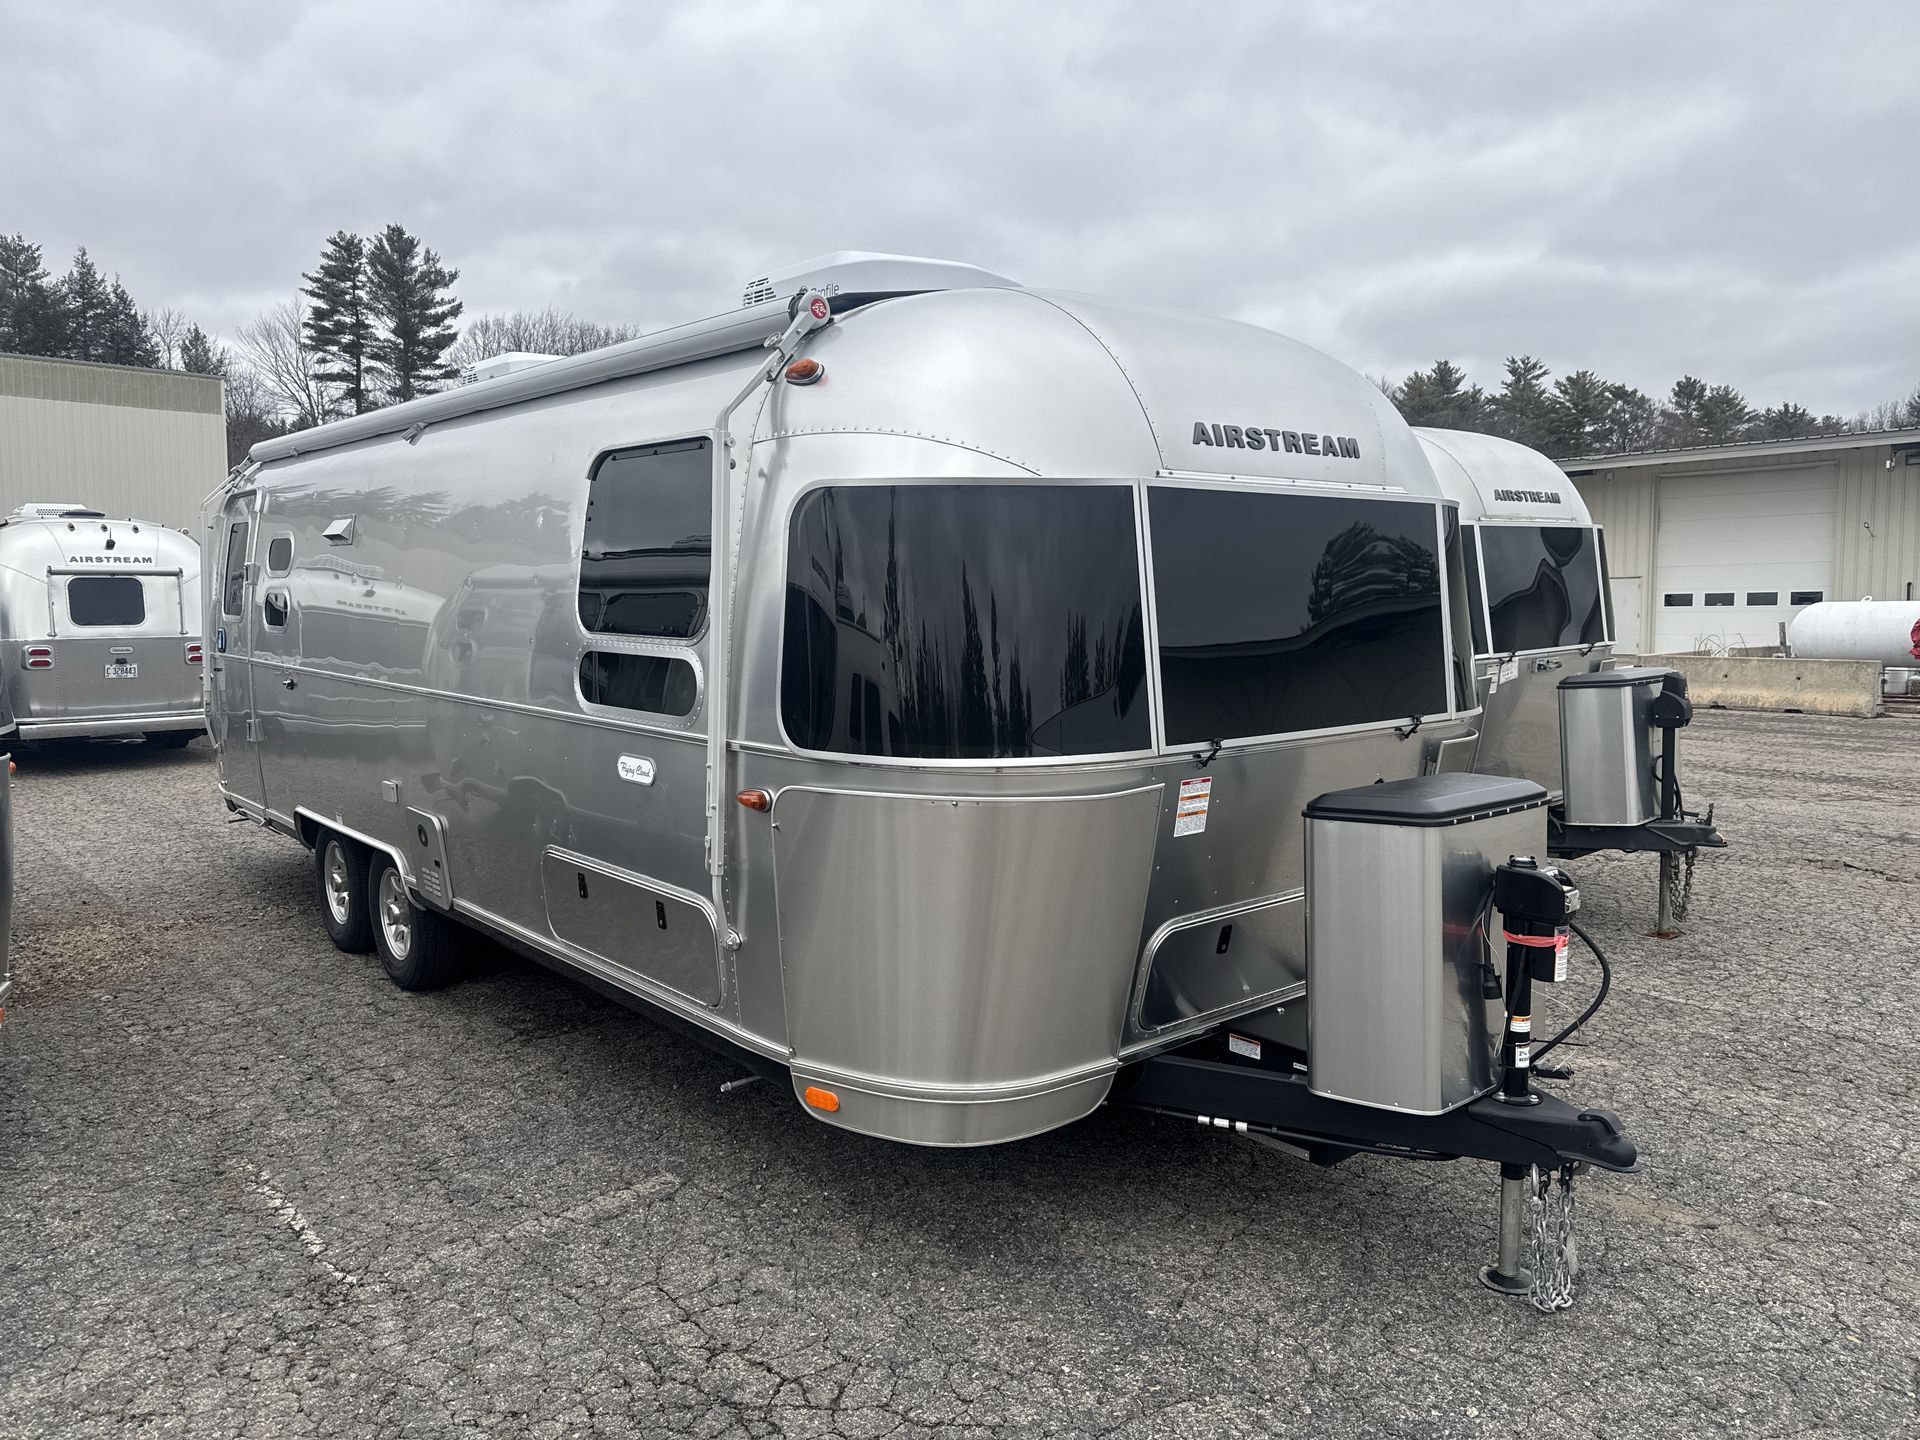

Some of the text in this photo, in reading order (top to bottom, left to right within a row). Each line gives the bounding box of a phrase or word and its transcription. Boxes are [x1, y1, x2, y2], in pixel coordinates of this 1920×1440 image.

[1192, 422, 1360, 459] AIRSTREAM
[1494, 489, 1561, 504] AIRSTREAM
[620, 761, 651, 778] Flying Cloud
